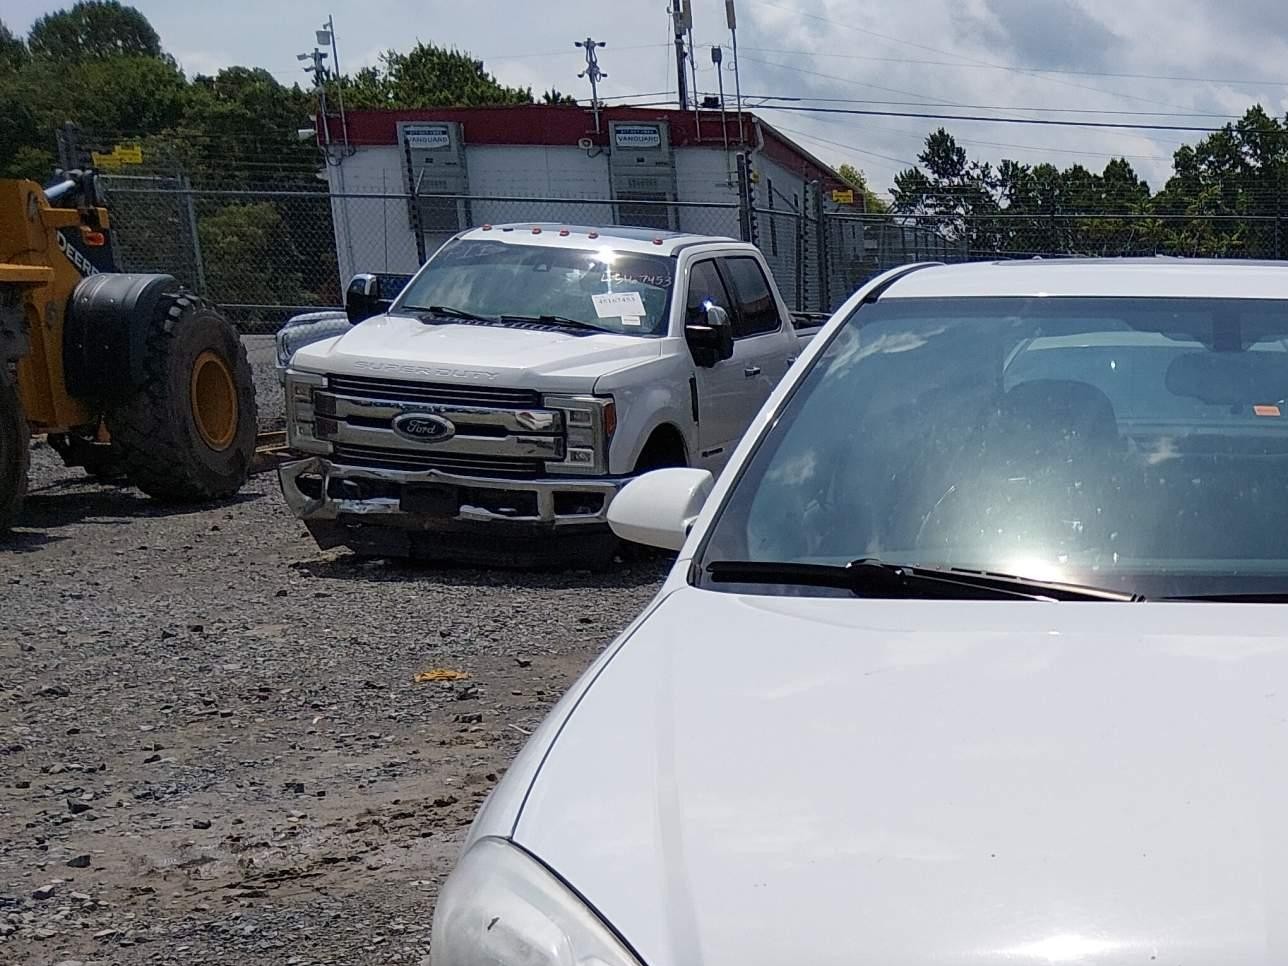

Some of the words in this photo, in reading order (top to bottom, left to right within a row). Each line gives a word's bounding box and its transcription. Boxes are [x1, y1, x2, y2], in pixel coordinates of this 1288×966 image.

[353, 360, 431, 375] SUPER
[434, 368, 500, 380] DUTY
[406, 419, 437, 434] Ford
